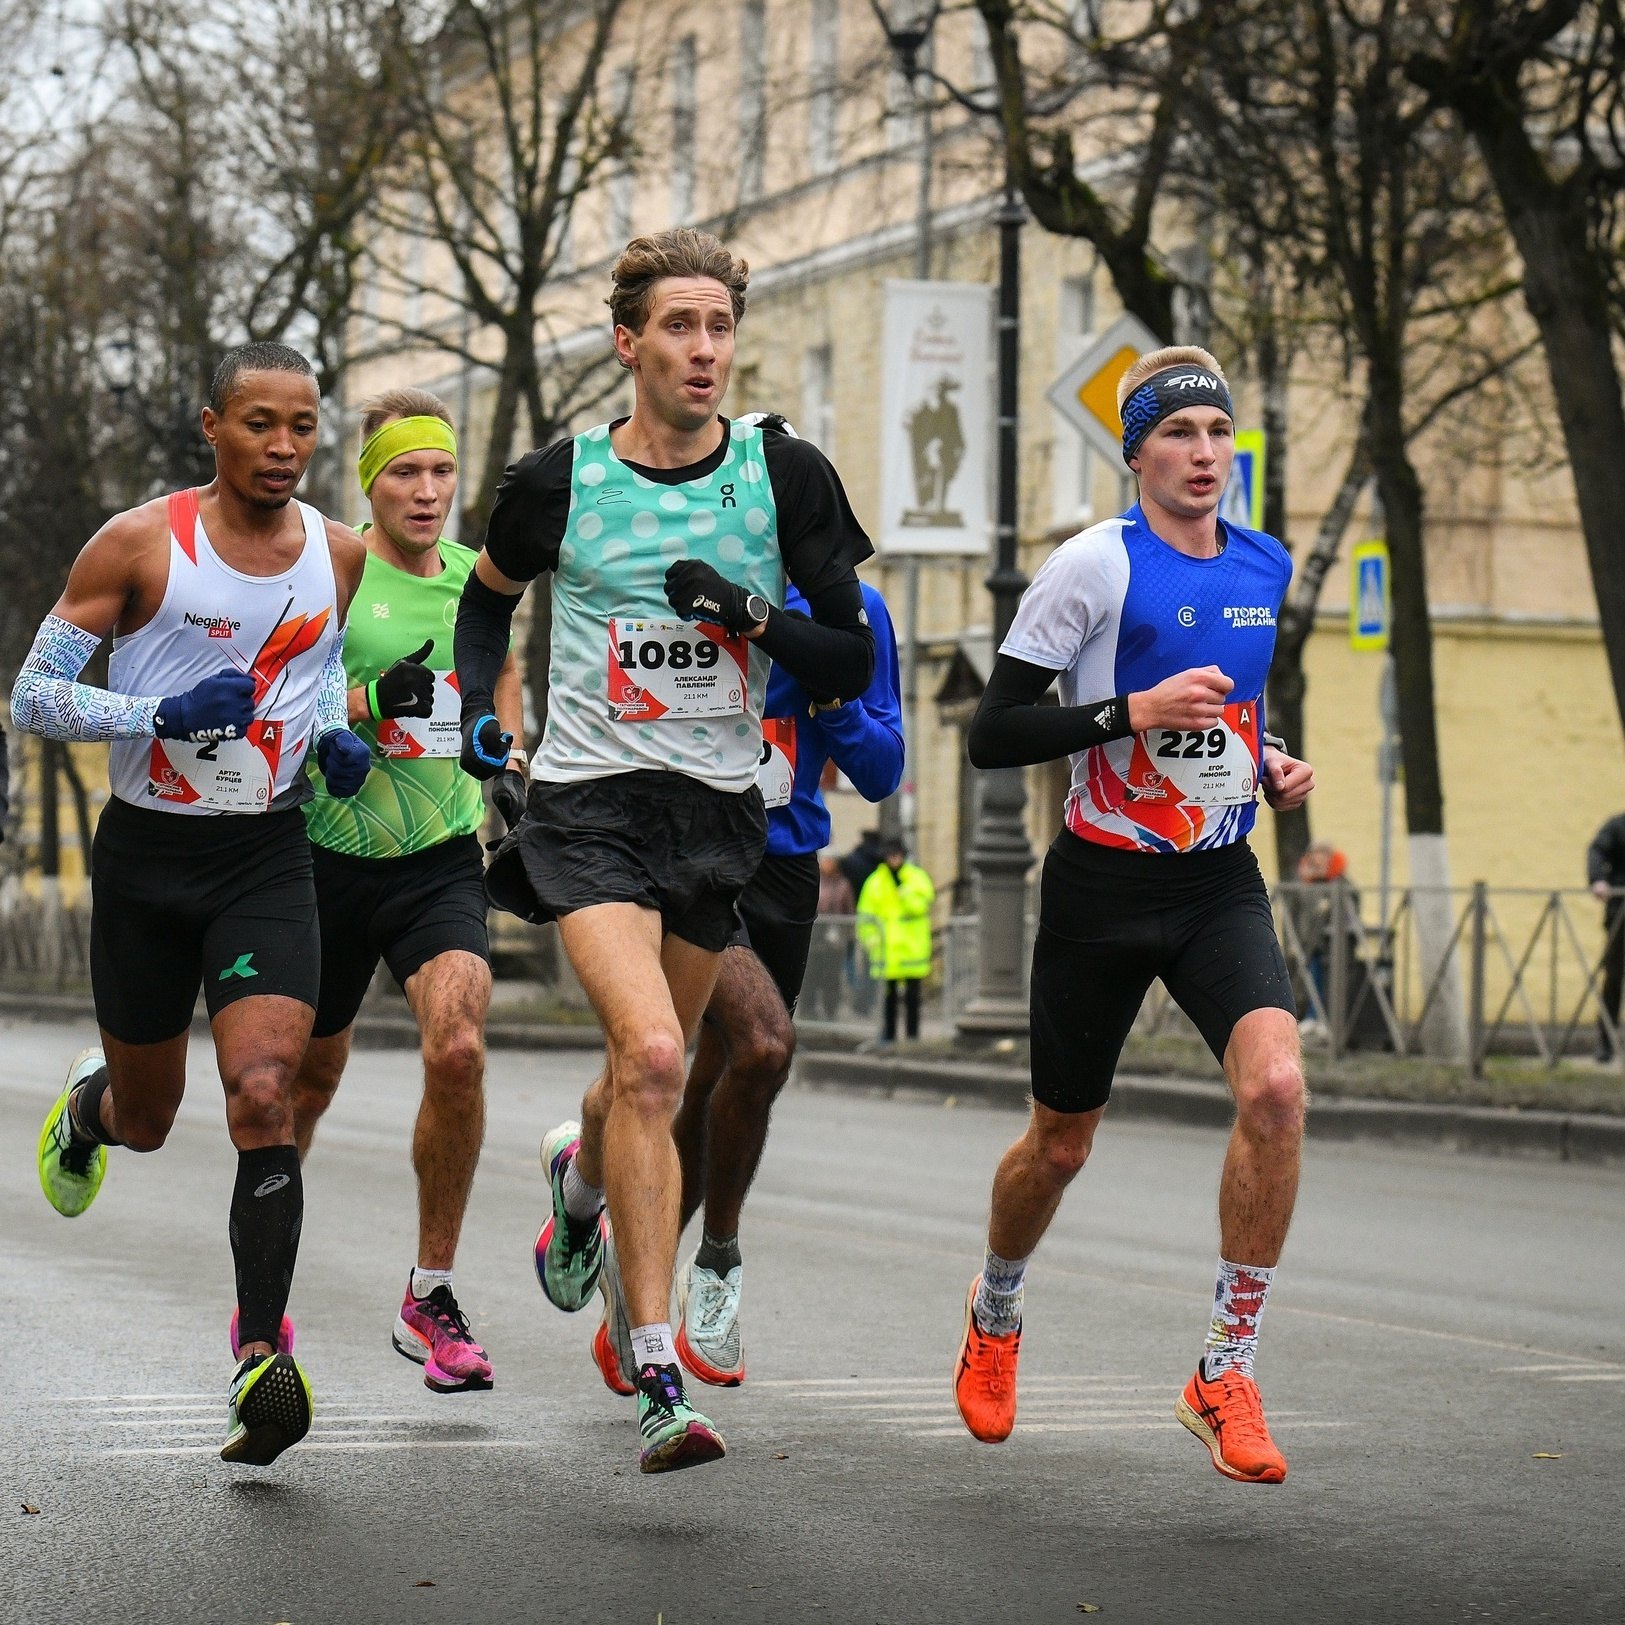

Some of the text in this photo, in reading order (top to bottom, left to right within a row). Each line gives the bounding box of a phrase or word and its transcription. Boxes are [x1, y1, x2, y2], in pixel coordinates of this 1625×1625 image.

[1166, 374, 1217, 390] RAY
[1223, 606, 1271, 619] ВТОРОЕ
[184, 612, 241, 630] Negative
[1232, 618, 1276, 628] ДЫХАНИЕ
[211, 629, 230, 637] SPLIT
[618, 640, 720, 670] 1089
[196, 740, 219, 761] 2
[1157, 729, 1226, 758] 229
[215, 776, 242, 784] БУРЦЕВ
